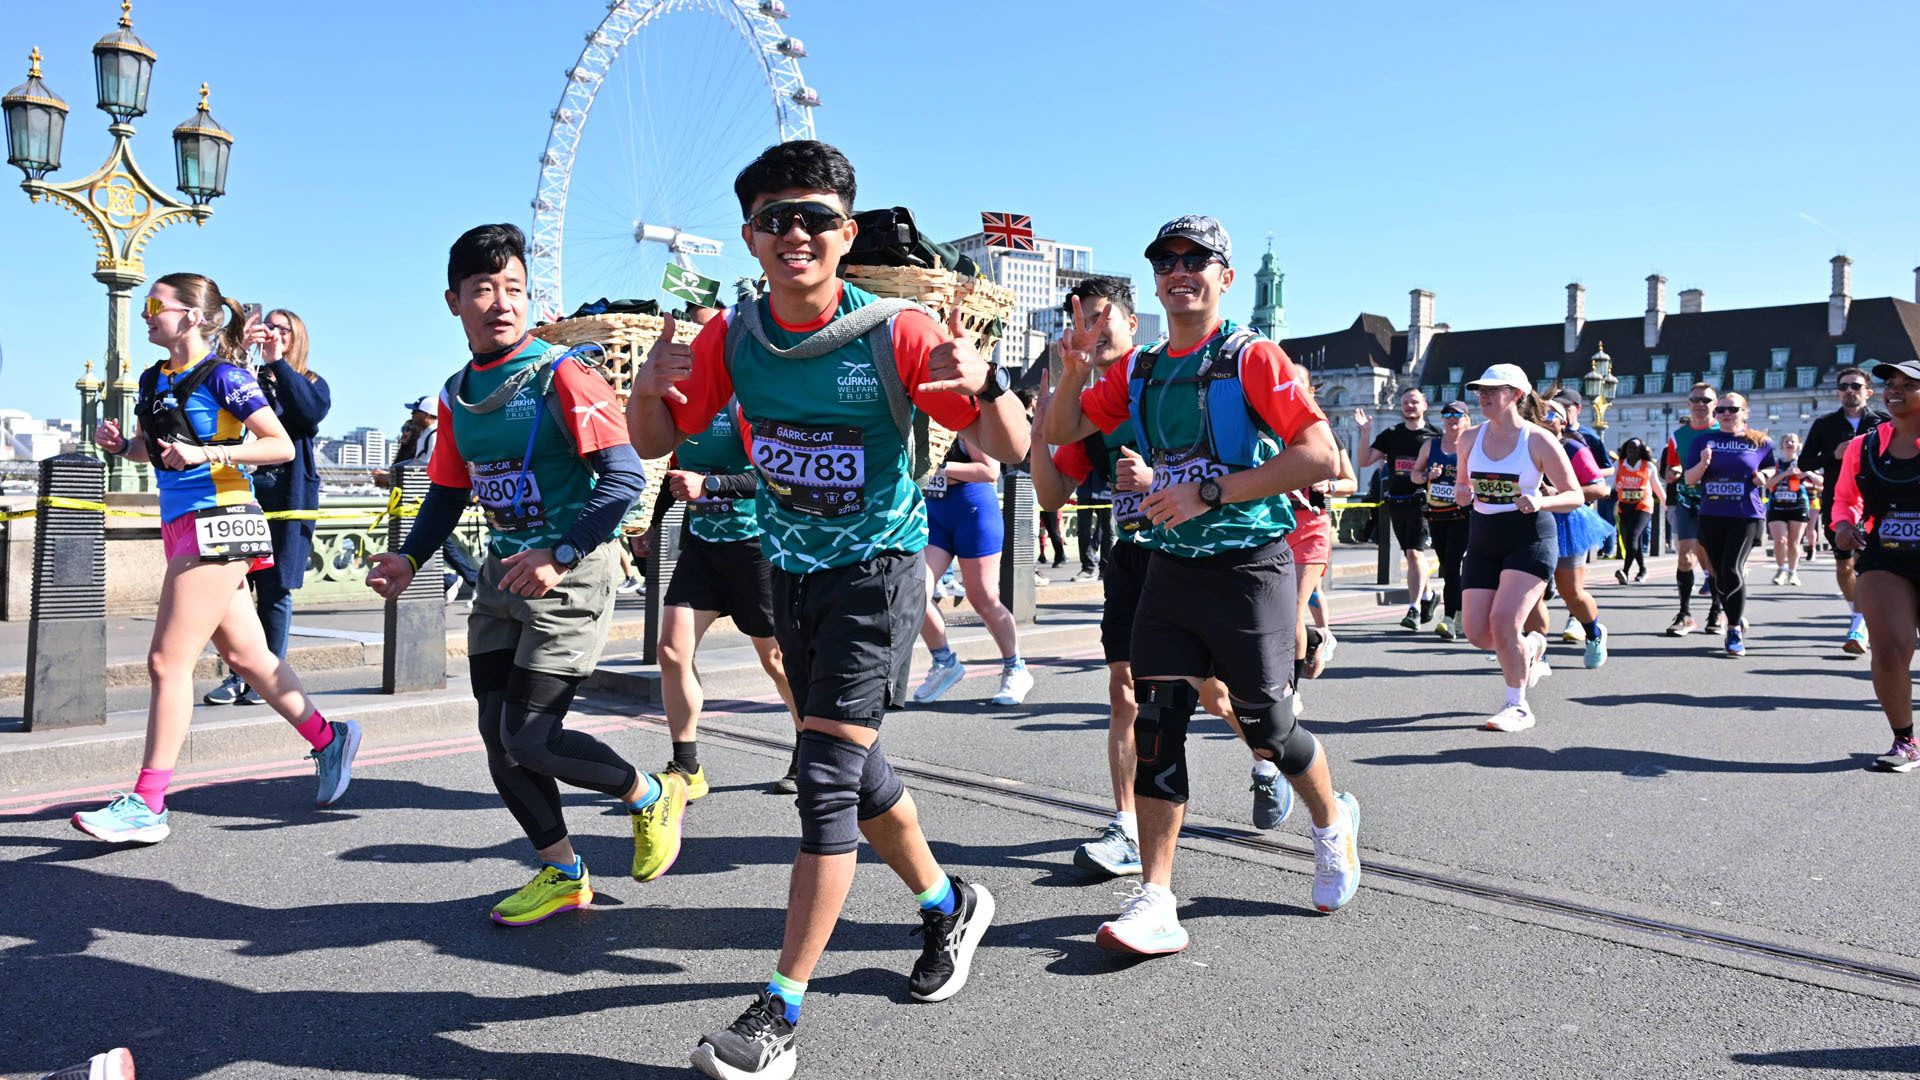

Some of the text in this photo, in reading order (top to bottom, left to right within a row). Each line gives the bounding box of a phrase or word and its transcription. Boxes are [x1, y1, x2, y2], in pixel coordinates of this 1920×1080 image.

[837, 376, 878, 386] GURKHA
[776, 427, 834, 442] GARRC-CAT
[1716, 441, 1758, 451] willow
[758, 444, 858, 482] 22783
[1707, 484, 1742, 493] 21096
[226, 505, 246, 513] WIZZ
[204, 519, 266, 538] 19605
